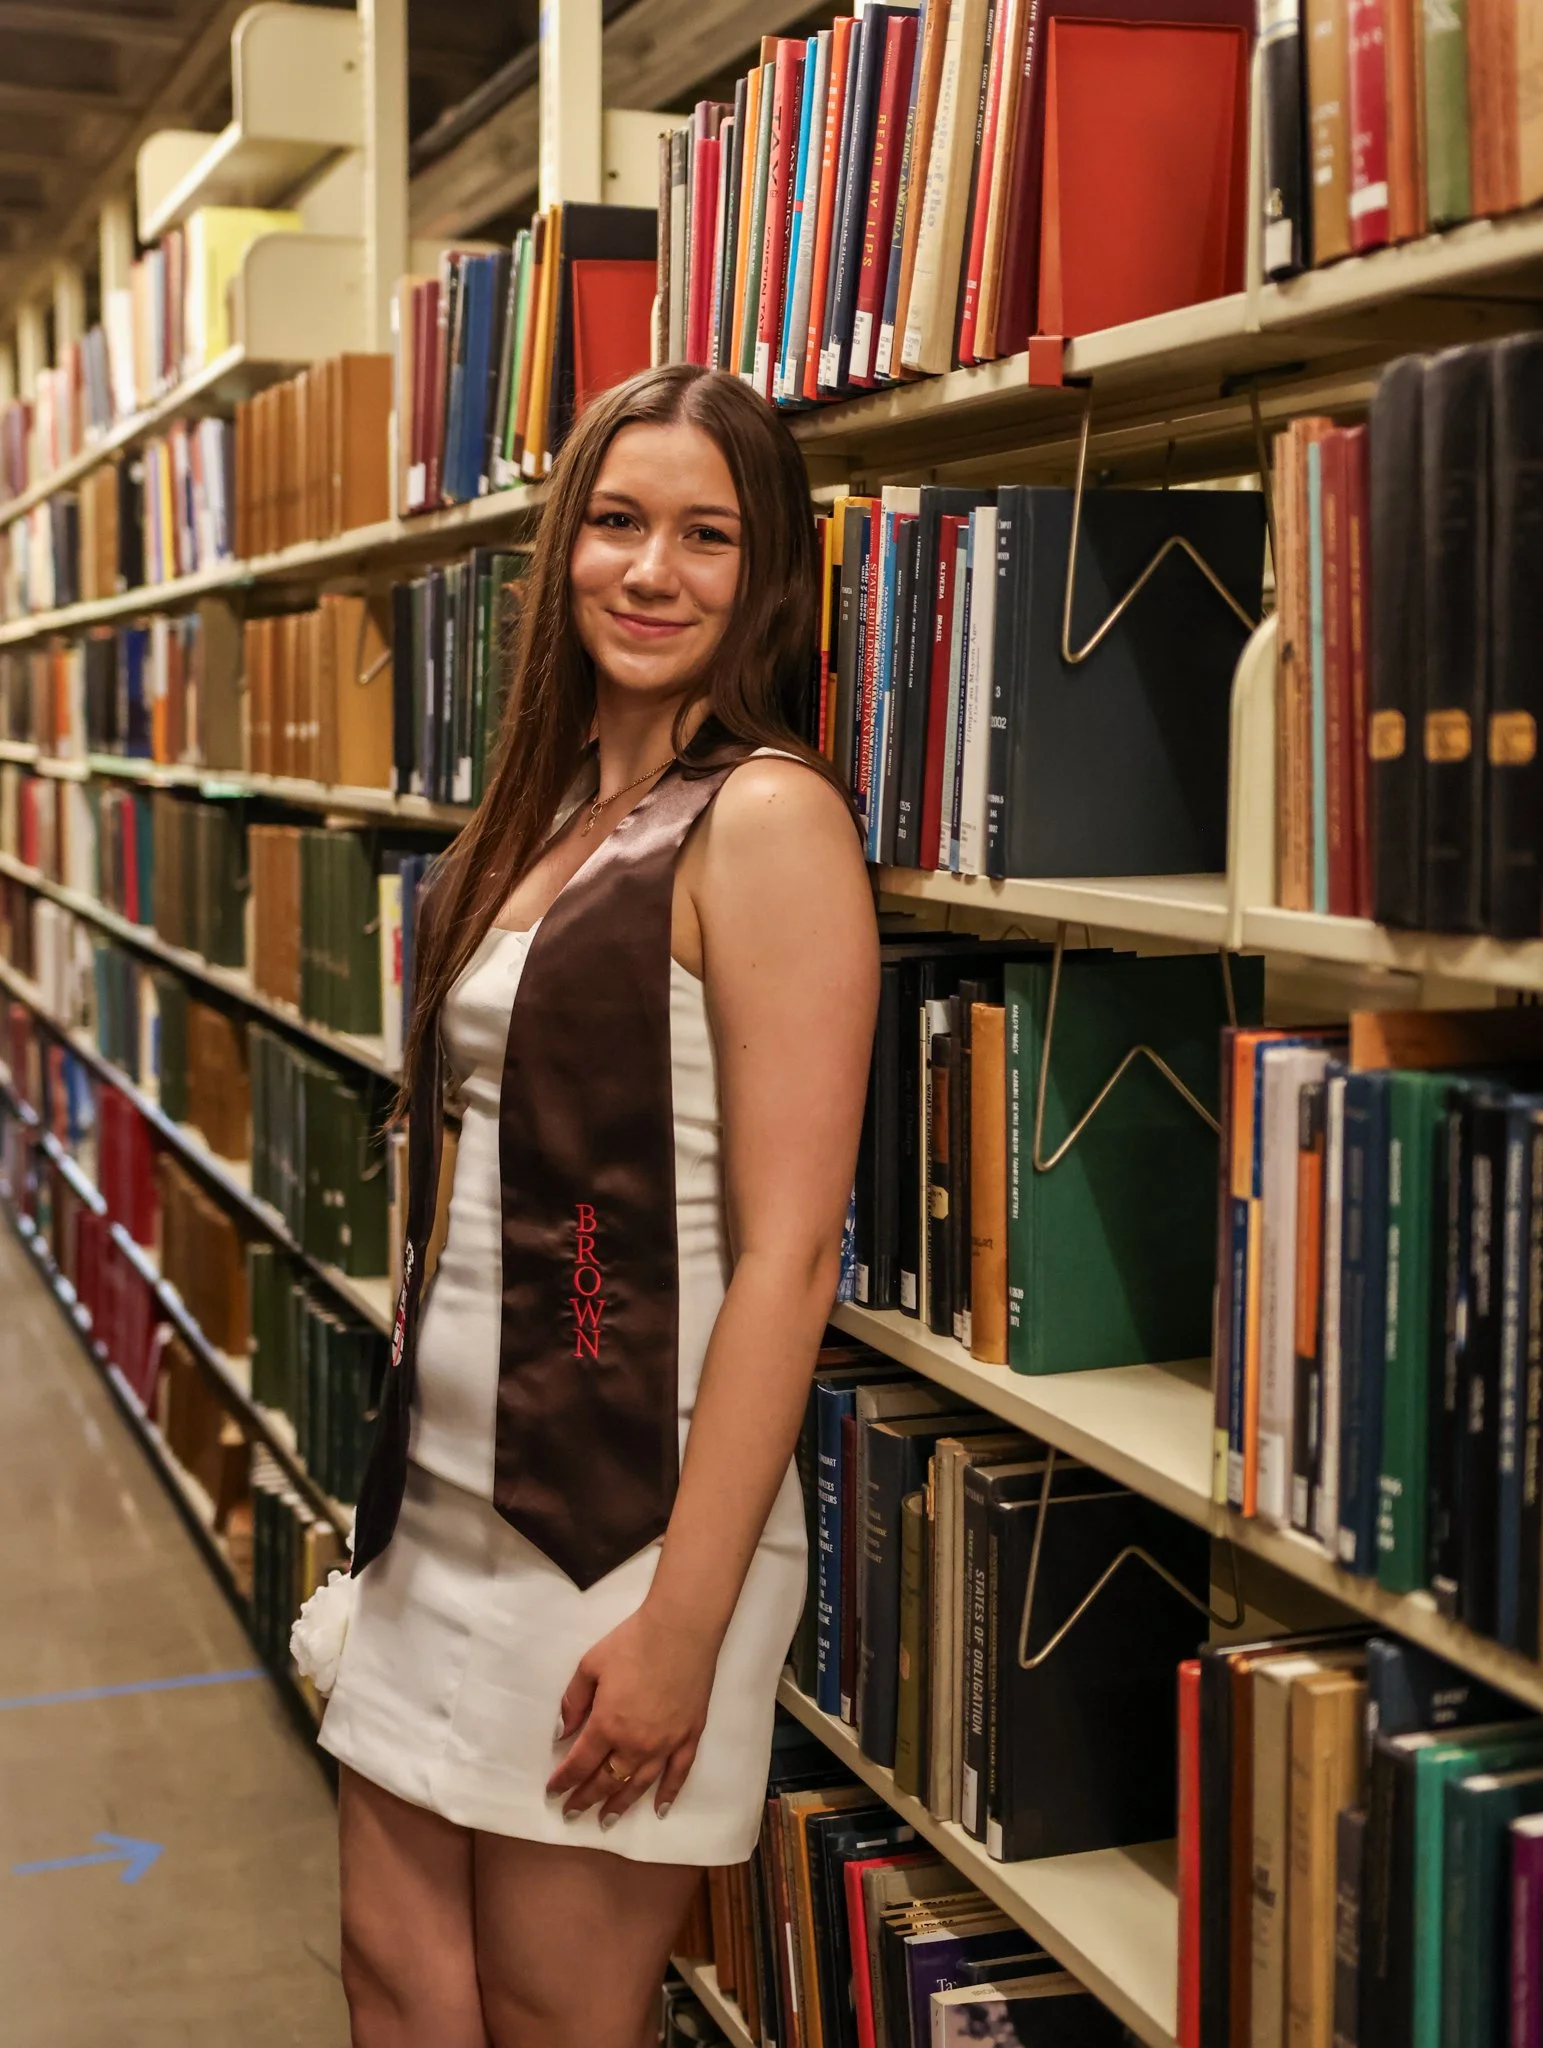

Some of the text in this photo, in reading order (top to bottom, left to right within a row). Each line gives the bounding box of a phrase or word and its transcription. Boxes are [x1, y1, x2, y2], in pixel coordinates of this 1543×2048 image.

[981, 63, 989, 90] LOCAL
[975, 115, 983, 147] POLICY
[789, 142, 797, 172] TAX
[863, 114, 887, 267] READ MY LIPS
[892, 112, 914, 241] TAXING AMERICA
[784, 178, 794, 239] POLICY
[845, 184, 854, 216] Reform
[839, 246, 849, 265] 21st
[836, 266, 846, 303] Century
[865, 562, 878, 672] STATE-BUILDING
[936, 561, 947, 643] OLIVEIRA BRASIL
[864, 674, 872, 704] AND
[995, 685, 1002, 699] 3
[863, 707, 871, 732] TAX
[860, 735, 870, 792] REGIMES
[569, 1203, 606, 1359] BROWN
[971, 1568, 985, 1735] STATES OF OBLIGATION
